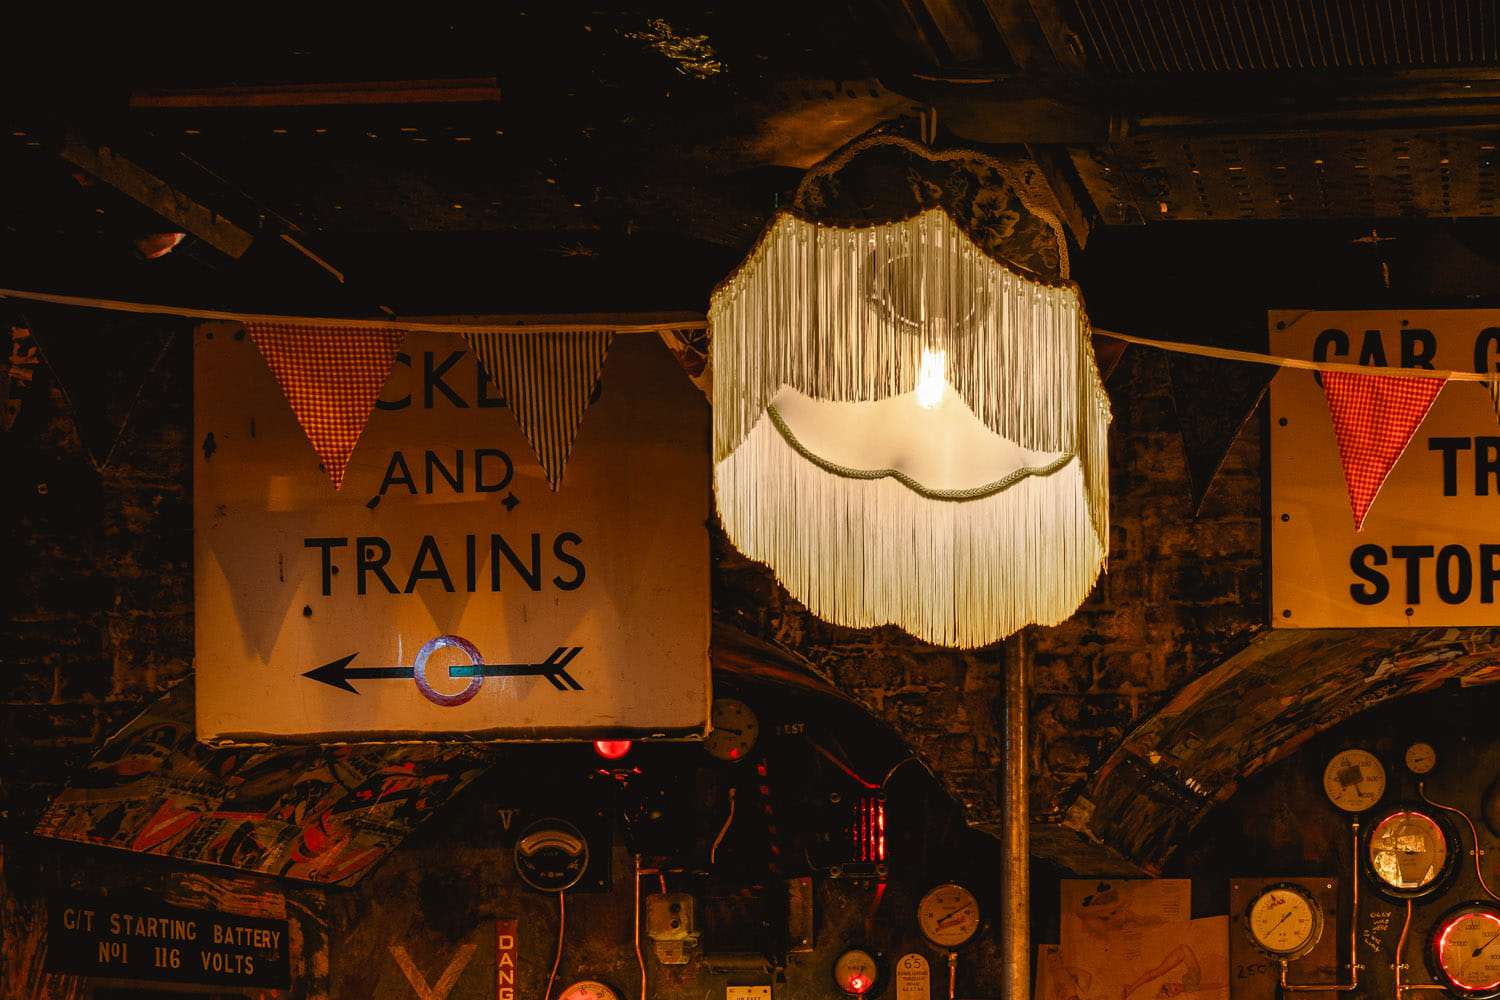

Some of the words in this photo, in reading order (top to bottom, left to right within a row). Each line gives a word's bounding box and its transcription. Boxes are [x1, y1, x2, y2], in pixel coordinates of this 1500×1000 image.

[379, 448, 514, 495] AND
[304, 531, 587, 596] TRAINS
[63, 908, 95, 932] G/T
[110, 913, 197, 941] STARTING
[213, 924, 281, 949] BATTERY
[154, 946, 182, 969] 116
[201, 951, 255, 976] VOLTS
[904, 958, 921, 969] 65
